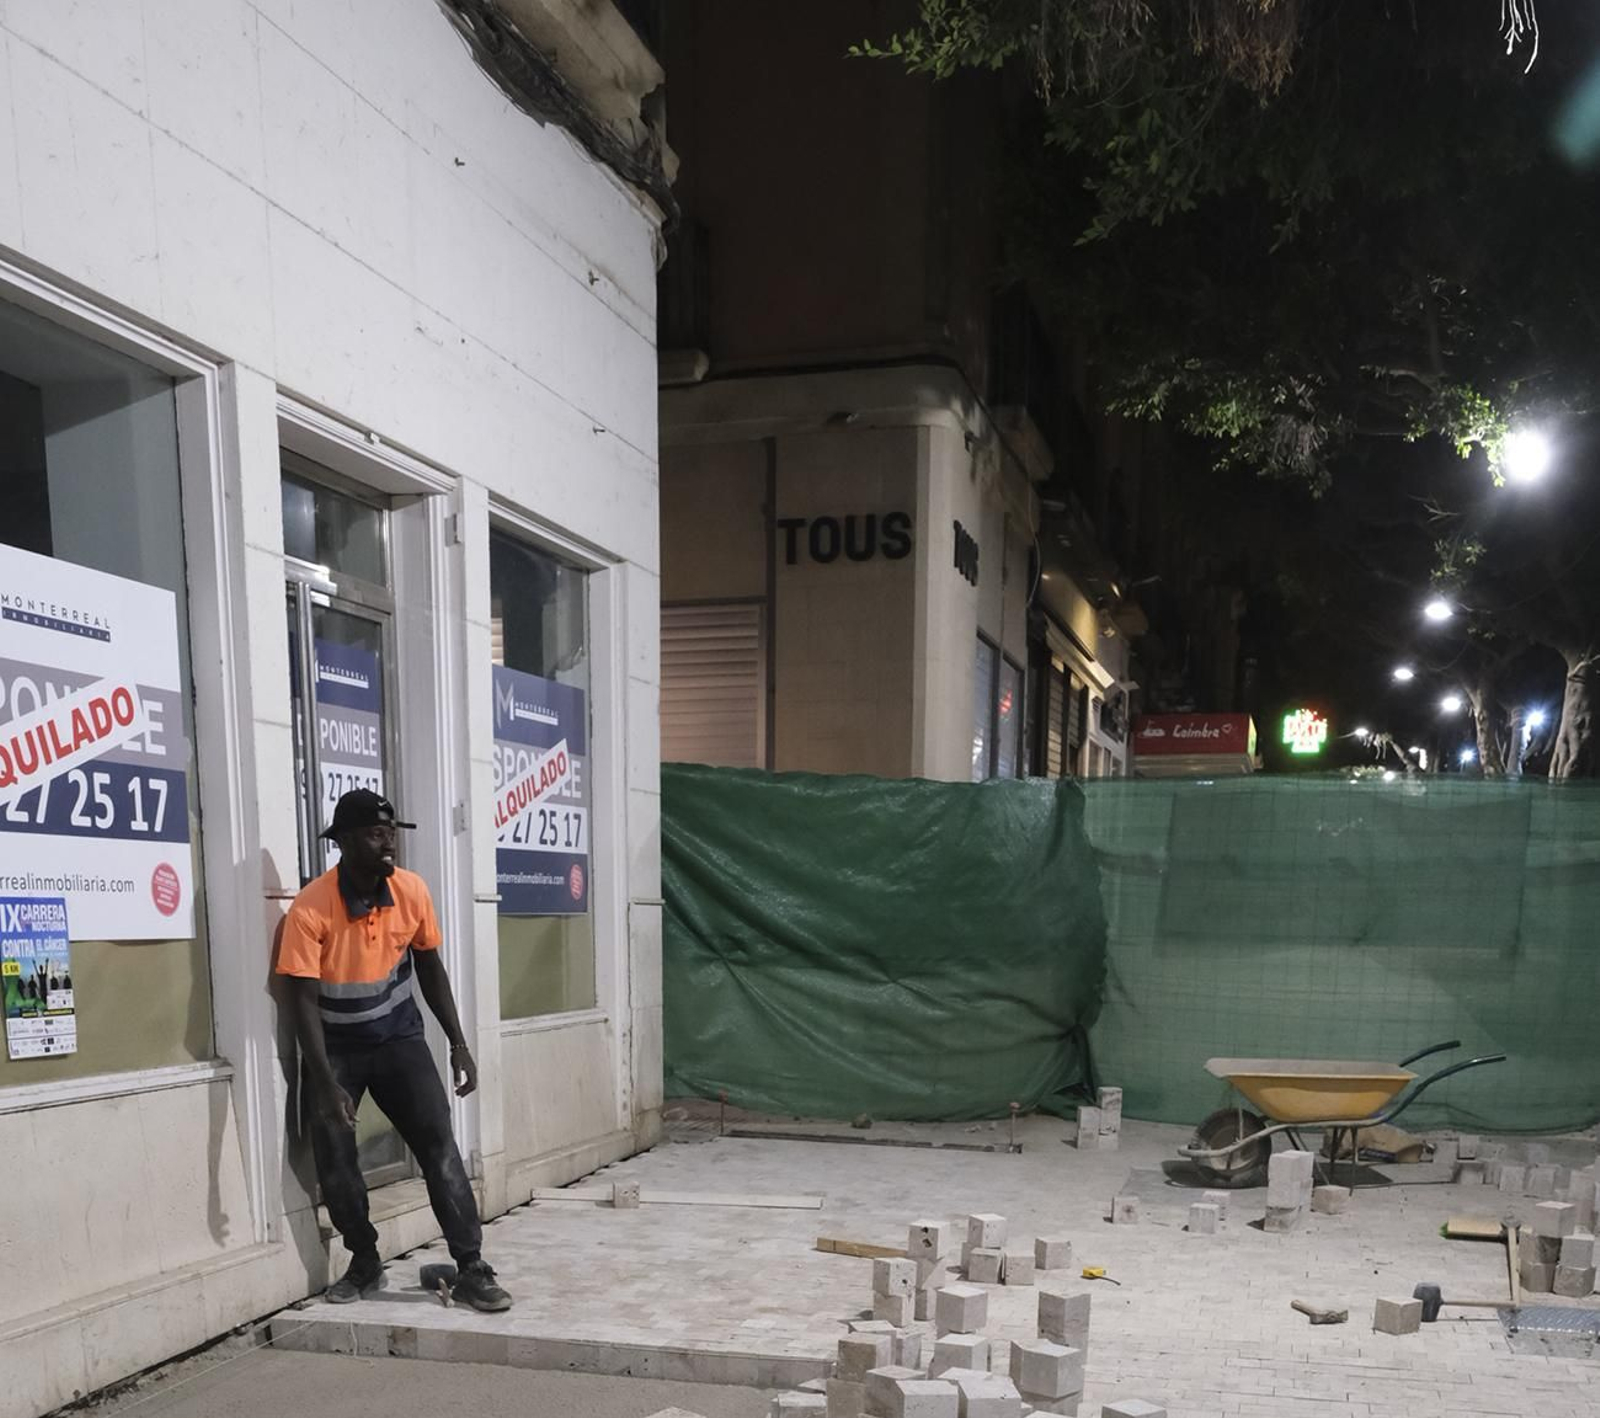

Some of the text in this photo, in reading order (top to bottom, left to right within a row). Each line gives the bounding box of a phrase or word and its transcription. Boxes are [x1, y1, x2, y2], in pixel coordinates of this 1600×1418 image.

[777, 512, 912, 565] TOUS
[1, 593, 110, 629] MONTERREAL
[0, 687, 135, 788] QUILADO
[320, 718, 378, 757] PONIBLE
[68, 769, 115, 829] 25
[128, 776, 168, 833] 17
[328, 772, 342, 801] 27
[539, 809, 558, 846] 25
[564, 812, 582, 848] 17
[0, 872, 135, 893] rrealinmobiliaria.com
[21, 904, 66, 920] CARRERA
[2, 938, 36, 957] CONTRA
